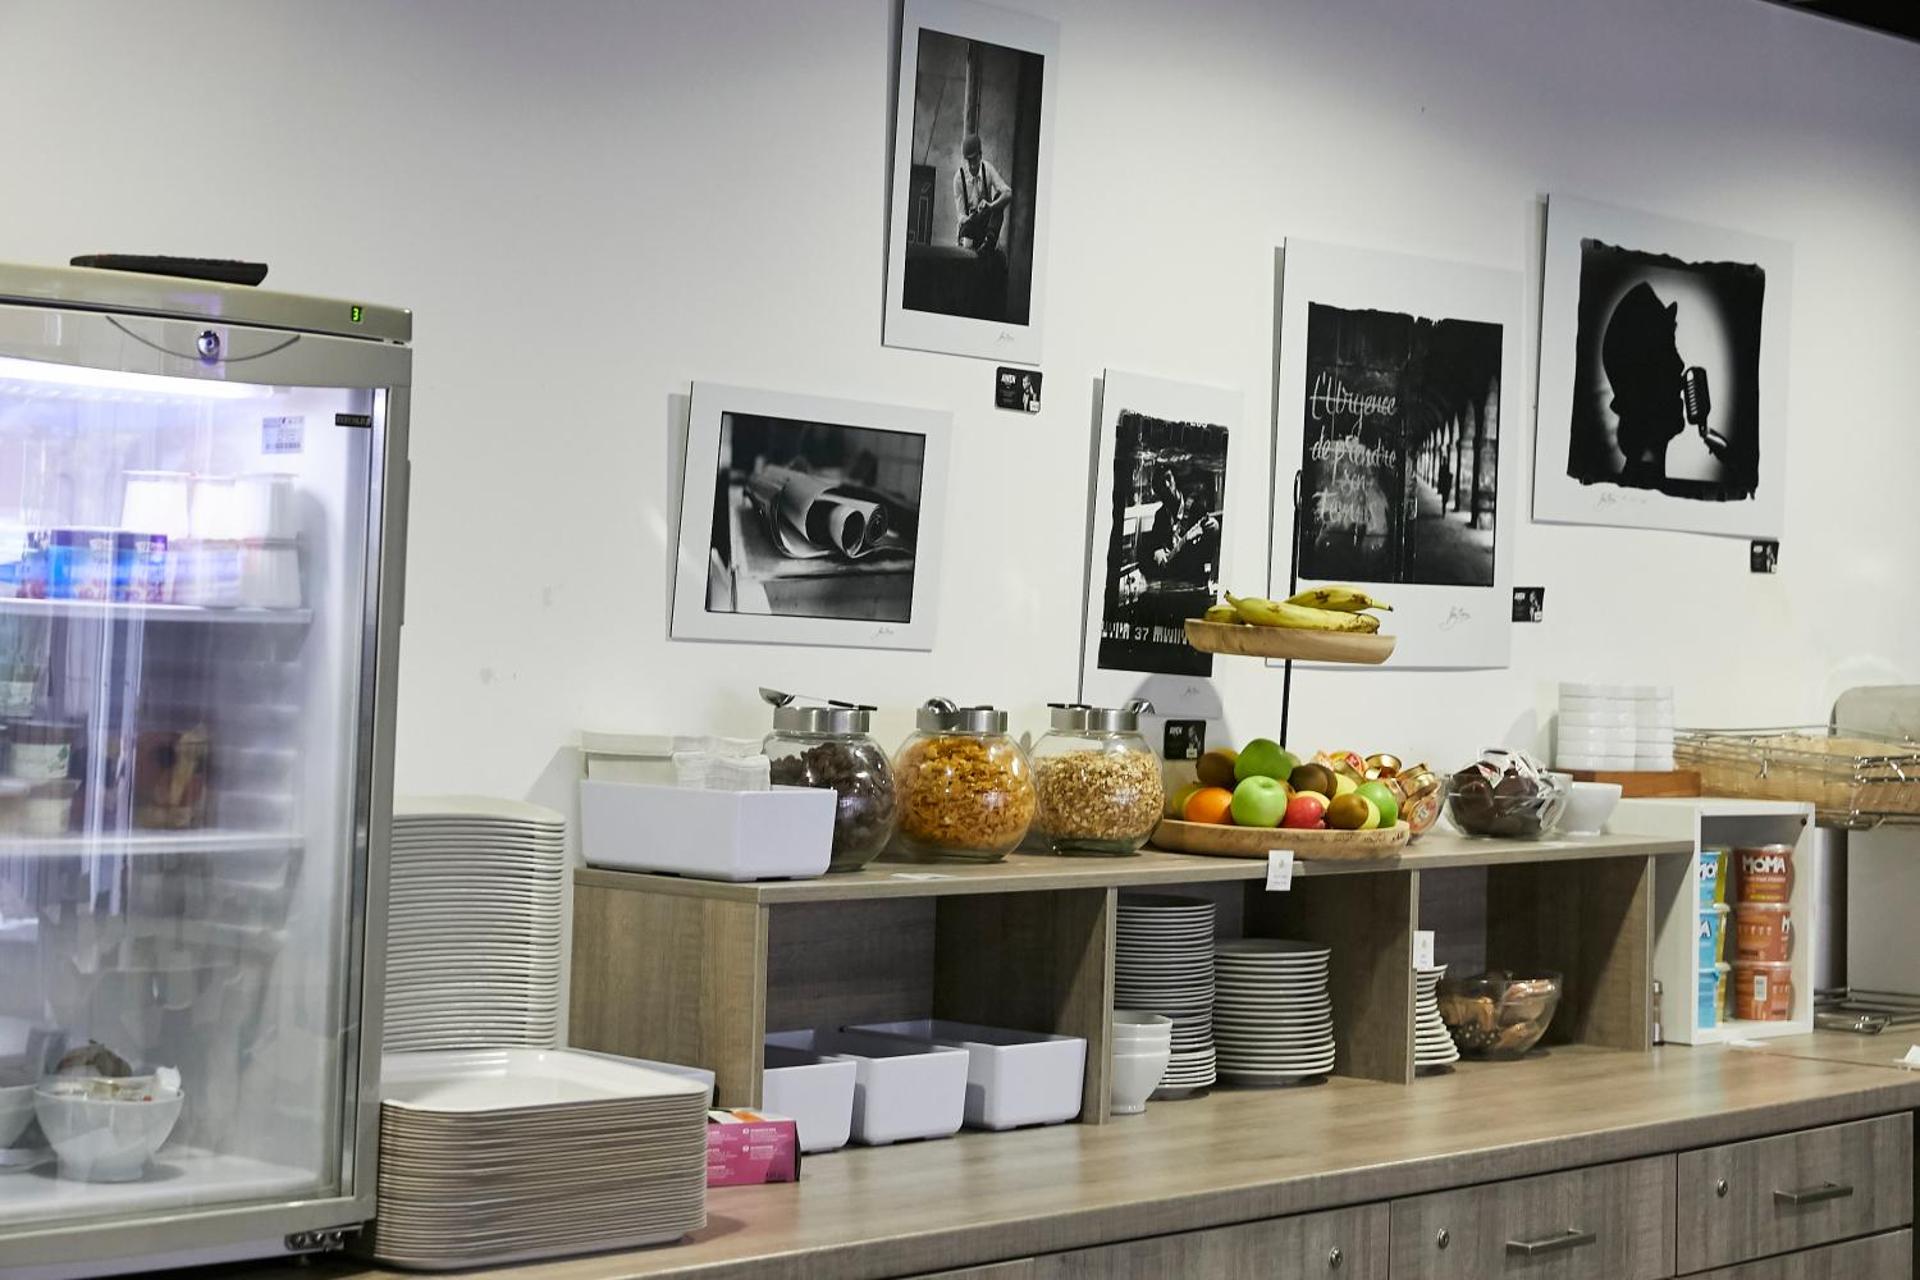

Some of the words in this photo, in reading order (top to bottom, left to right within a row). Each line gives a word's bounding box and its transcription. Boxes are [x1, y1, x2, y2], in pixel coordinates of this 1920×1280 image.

[353, 307, 360, 321] 3
[1134, 626, 1150, 641] 37
[1742, 855, 1786, 875] MOMA
